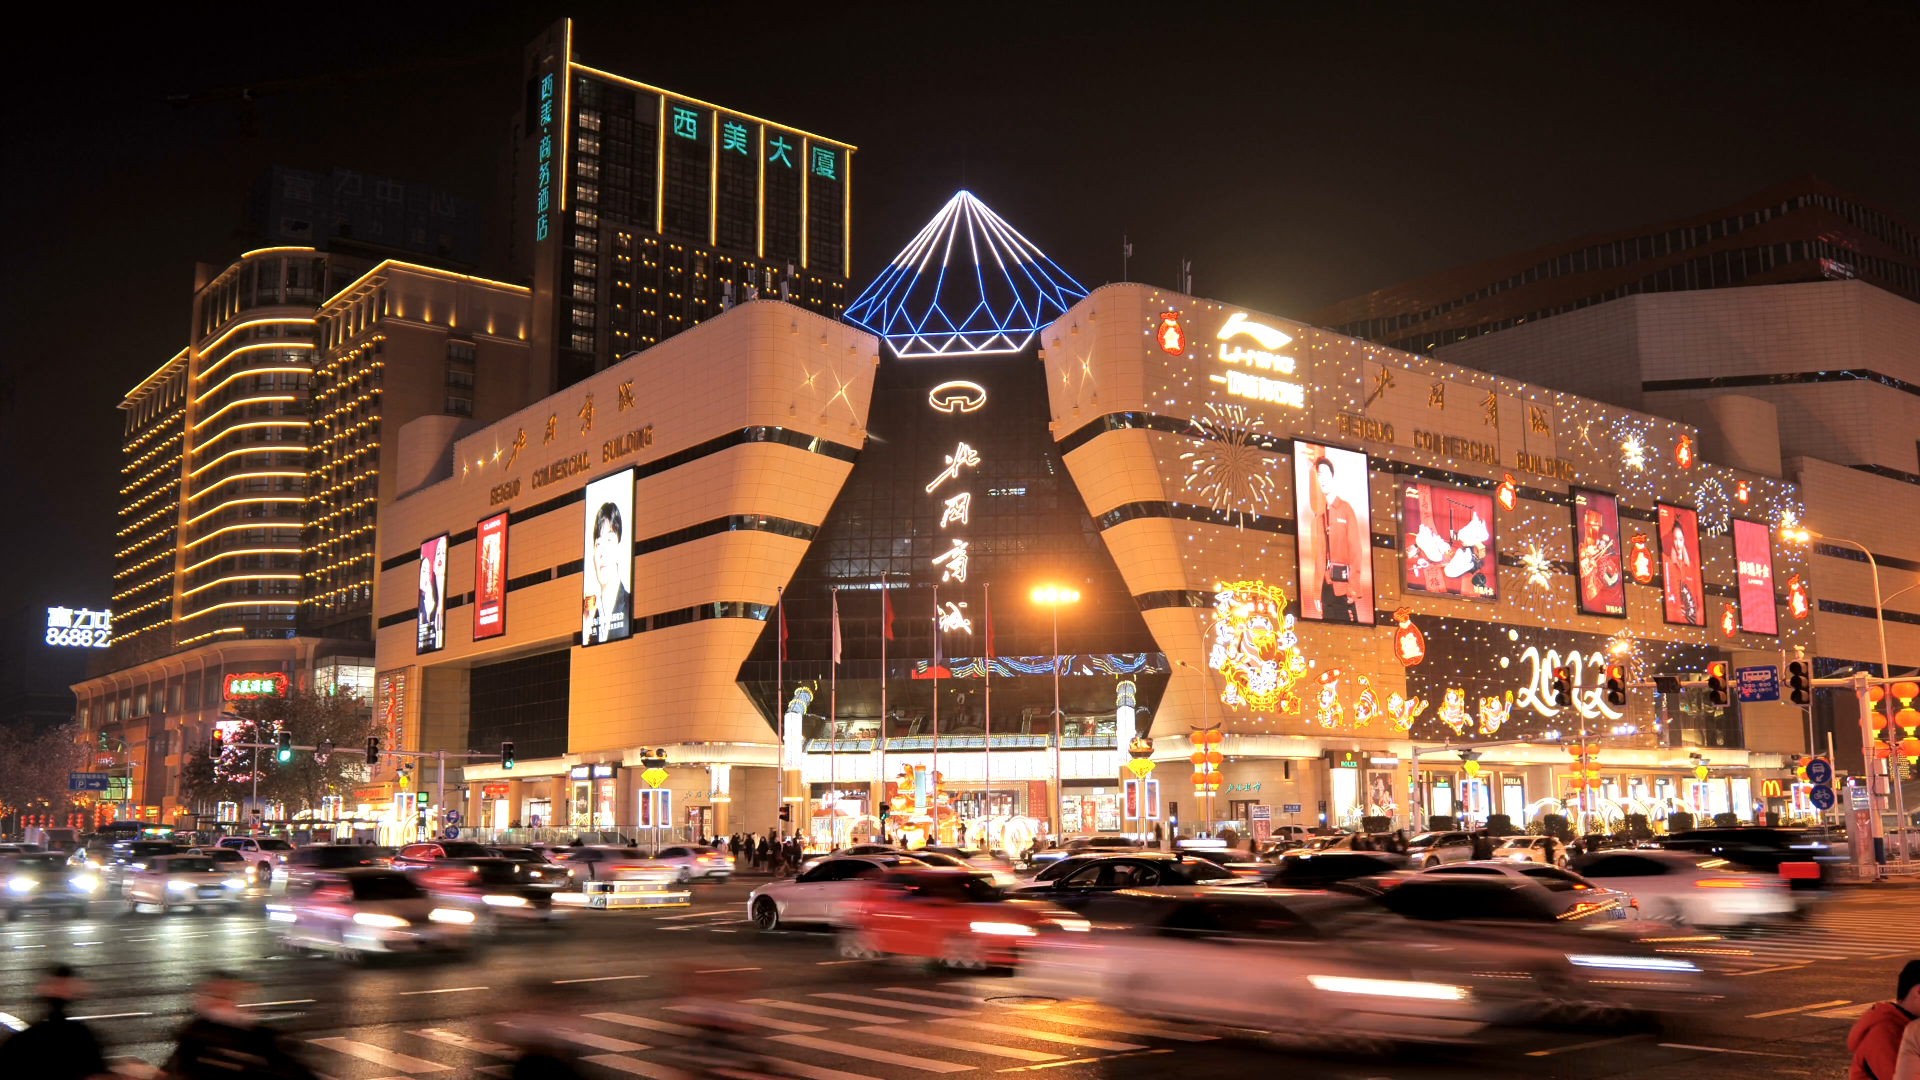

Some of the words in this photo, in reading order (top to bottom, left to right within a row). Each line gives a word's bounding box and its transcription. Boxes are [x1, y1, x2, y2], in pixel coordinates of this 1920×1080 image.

[672, 106, 837, 181] 西美大厦
[1218, 343, 1295, 374] LI-NING
[490, 477, 522, 507] BEIGUO
[602, 425, 654, 464] BUILDING
[1337, 411, 1395, 444] BEIGUO
[1515, 451, 1575, 483] BUILDING
[926, 441, 981, 635] 北国商城
[45, 627, 112, 648] 86882
[1516, 646, 1624, 720] 2022
